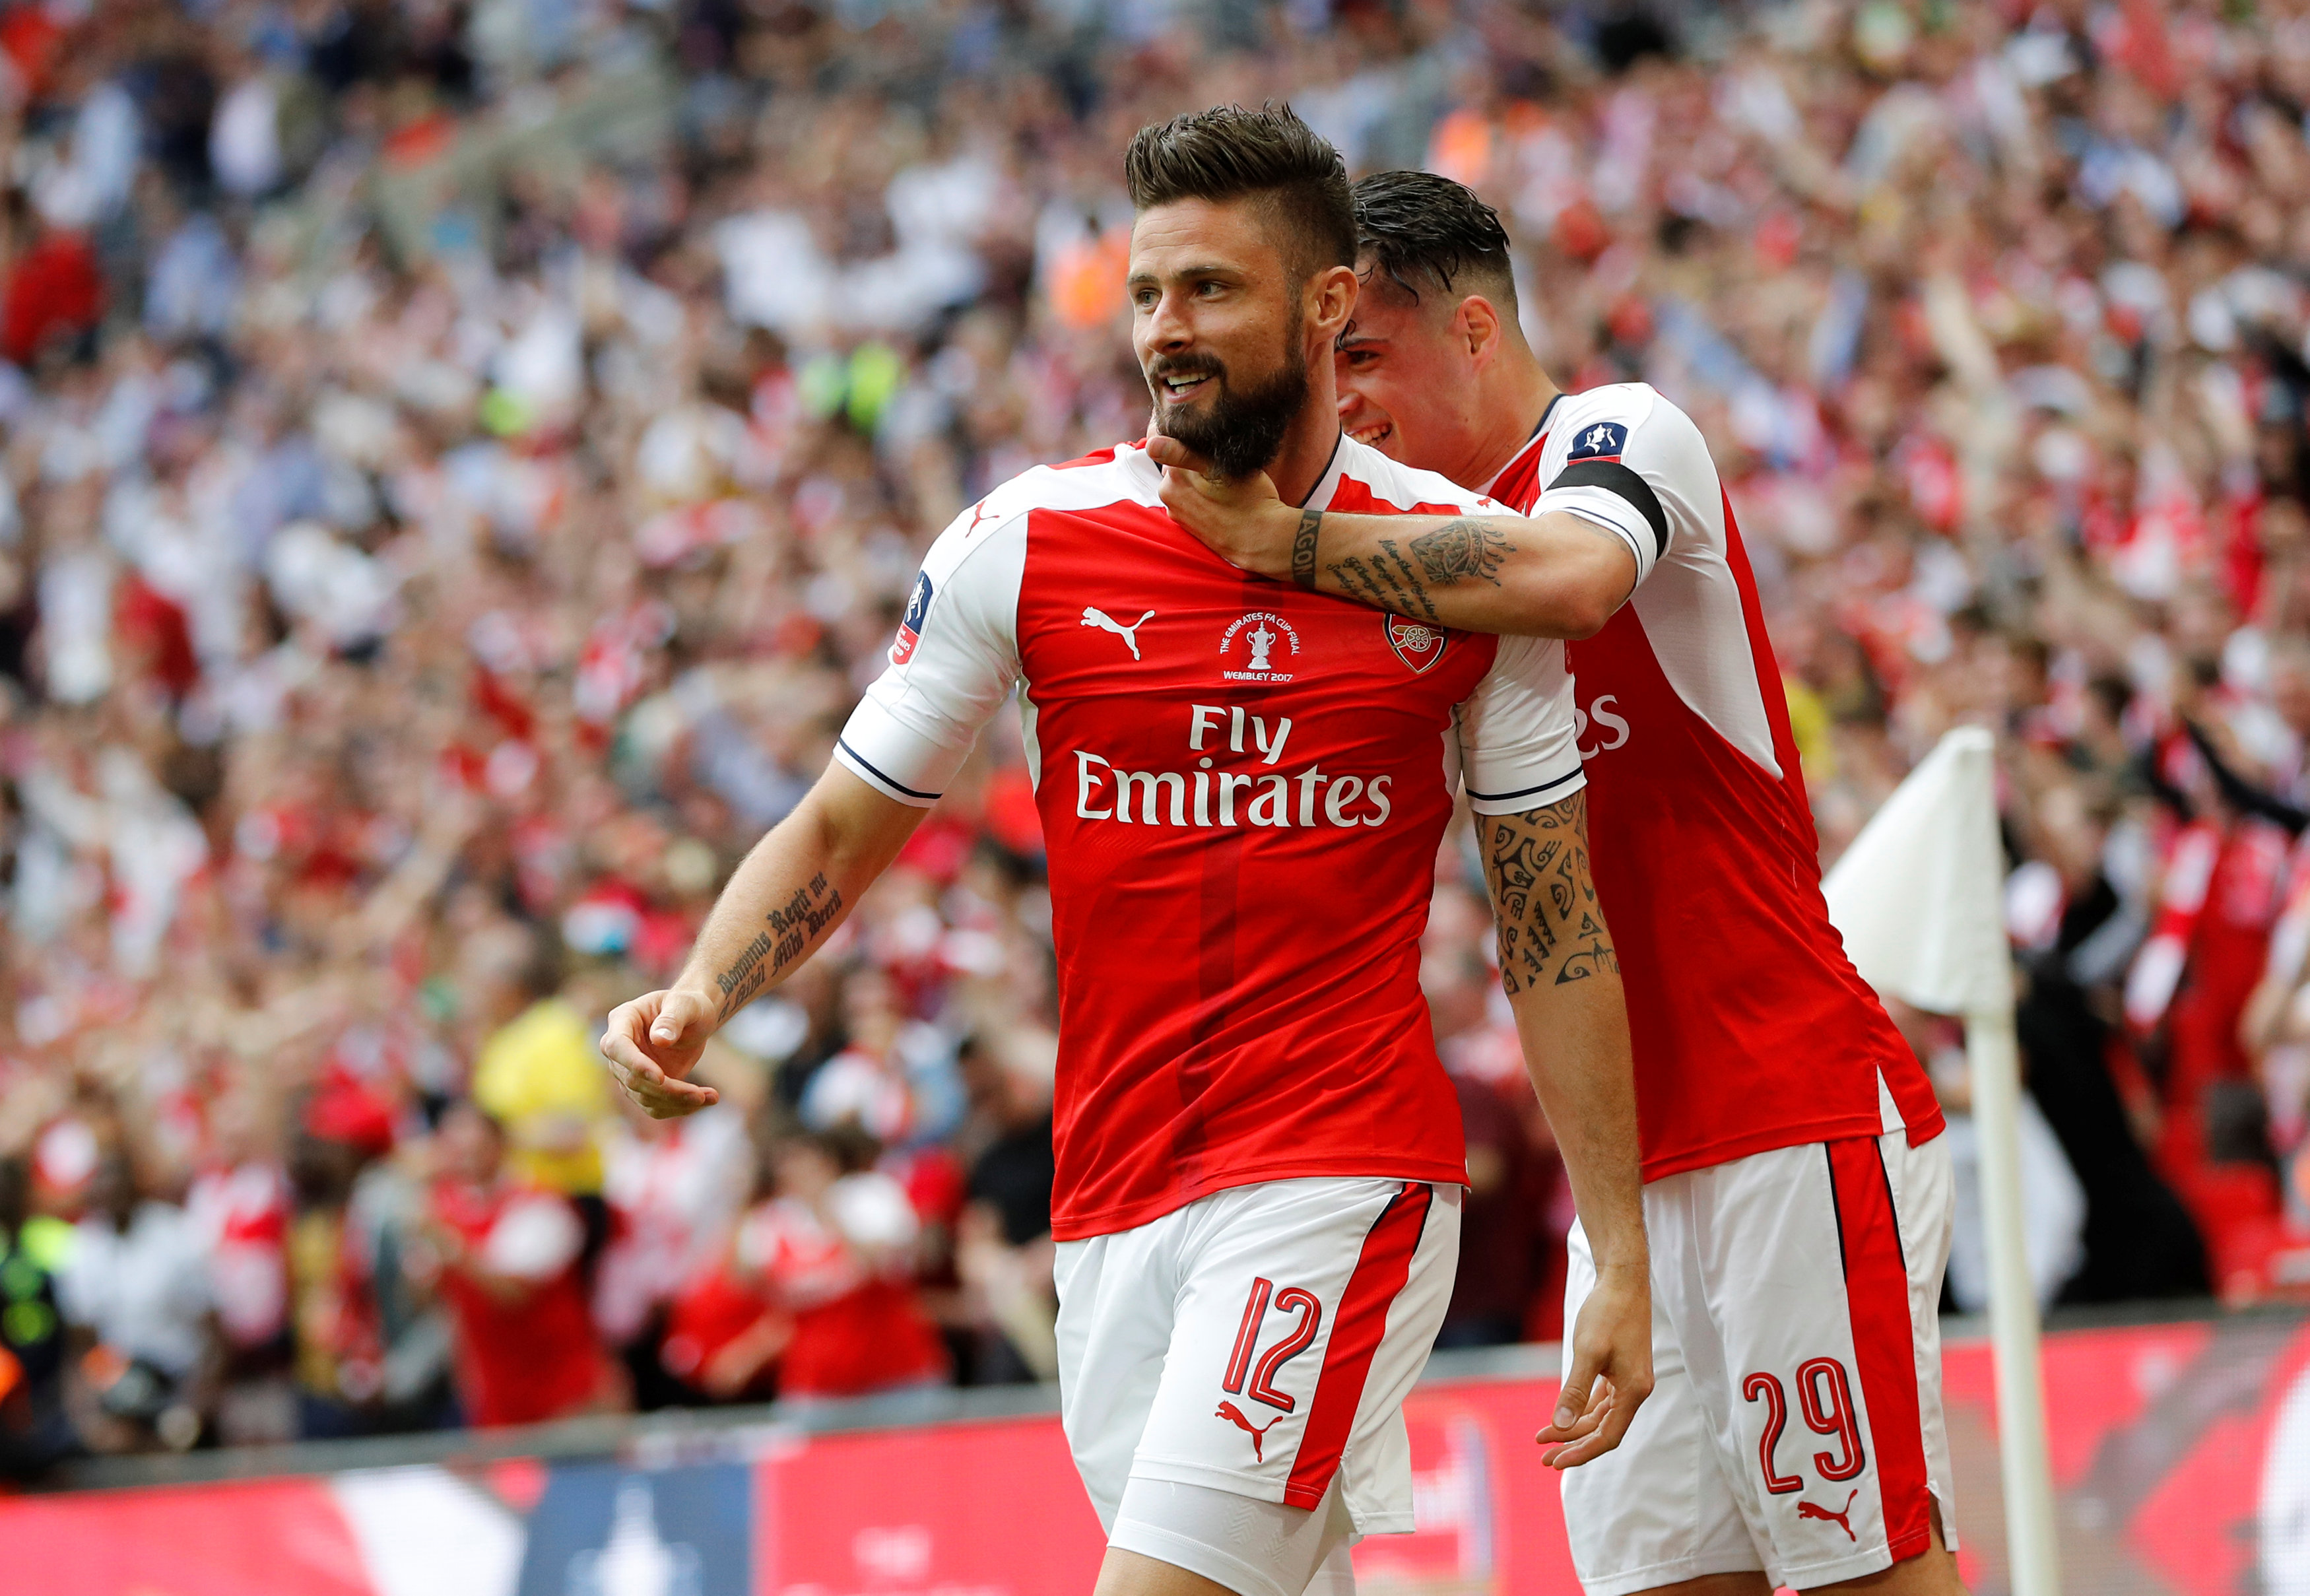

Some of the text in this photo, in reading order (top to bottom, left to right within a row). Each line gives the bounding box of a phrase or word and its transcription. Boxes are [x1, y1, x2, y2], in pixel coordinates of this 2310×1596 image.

[1220, 613, 1300, 655] THE EMIRATES FA CUP FINAL
[1224, 671, 1293, 682] WEMBLEY 2017
[1189, 704, 1292, 765] Fly
[1073, 750, 1391, 828] Emirates
[1222, 1277, 1321, 1413] 12
[1743, 1356, 1865, 1494] 29
